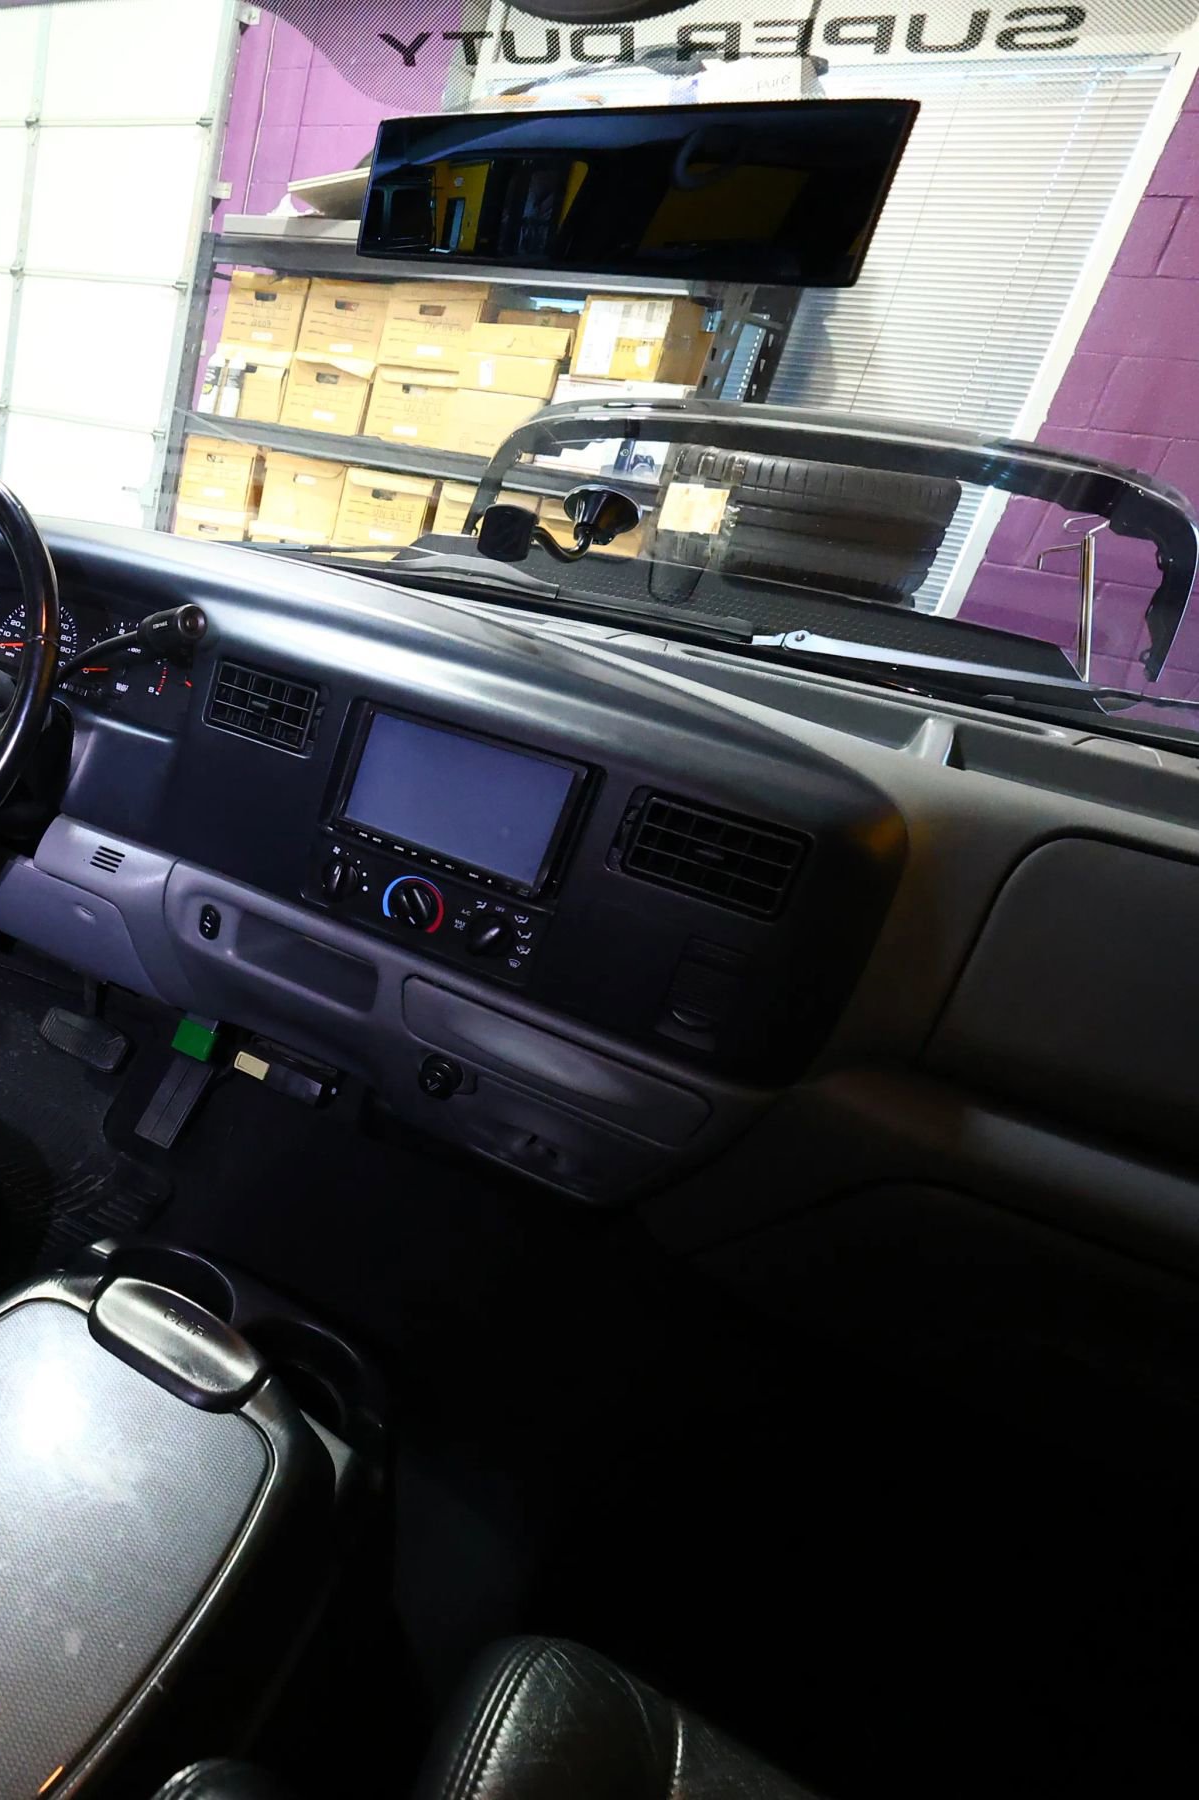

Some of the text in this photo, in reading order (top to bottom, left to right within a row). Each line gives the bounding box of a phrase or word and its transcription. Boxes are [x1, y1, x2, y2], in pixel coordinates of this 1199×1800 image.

[60, 634, 72, 643] 80
[60, 646, 71, 654] 90
[163, 1307, 207, 1337] CLIP
